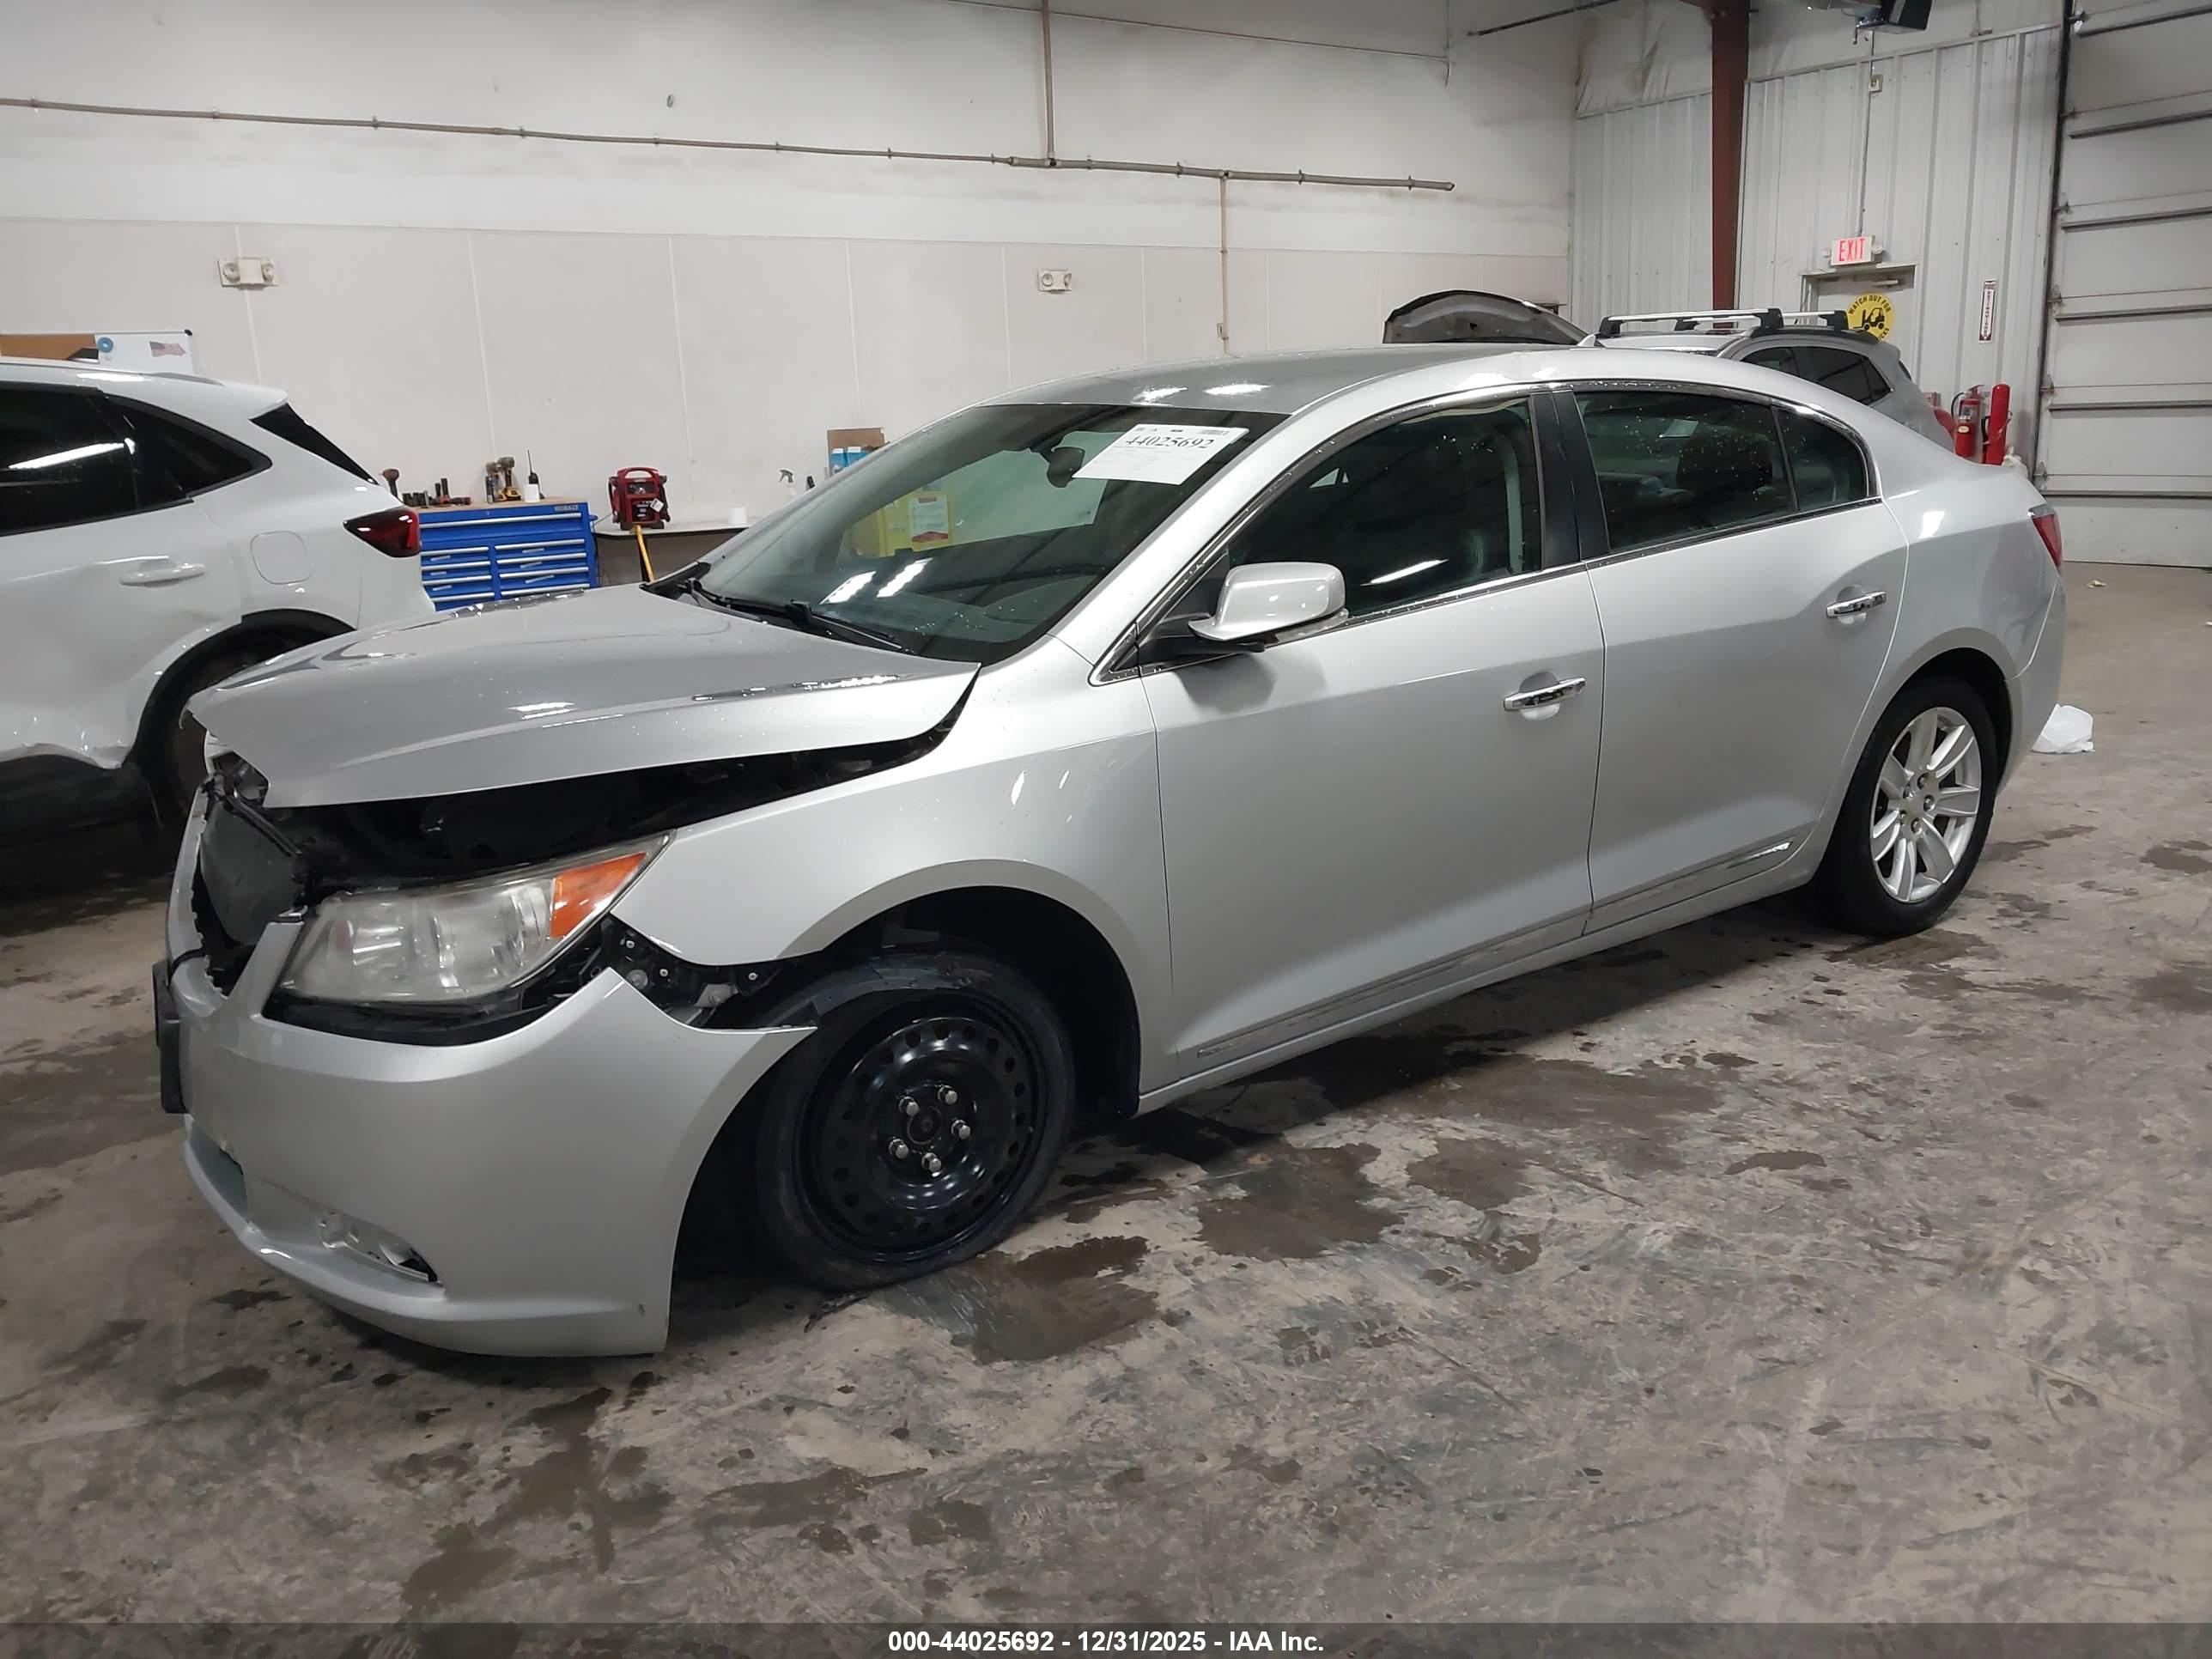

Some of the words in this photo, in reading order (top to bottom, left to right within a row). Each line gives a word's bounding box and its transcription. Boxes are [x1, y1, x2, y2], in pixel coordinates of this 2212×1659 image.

[1838, 238, 1866, 262] EXIT
[1848, 295, 1868, 315] WATCH
[1869, 295, 1882, 303] OUT
[1881, 299, 1892, 313] FOR
[1126, 434, 1215, 449] 44025692
